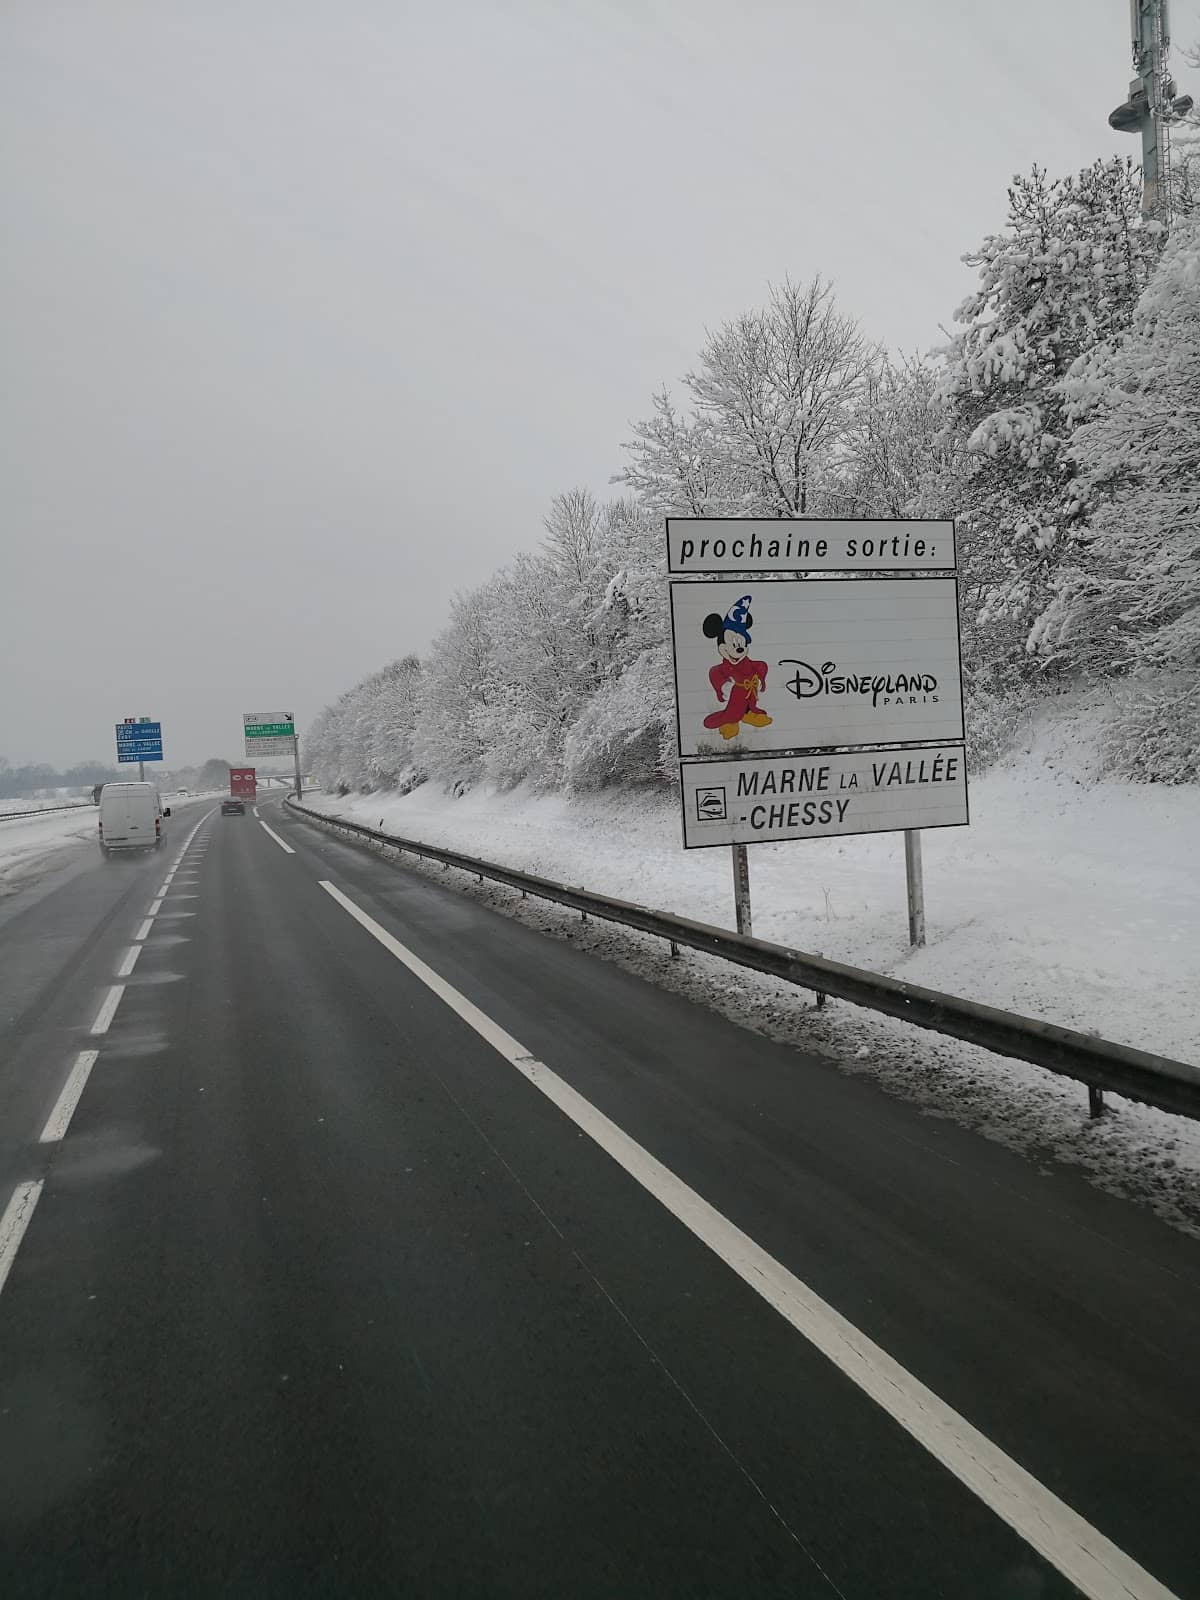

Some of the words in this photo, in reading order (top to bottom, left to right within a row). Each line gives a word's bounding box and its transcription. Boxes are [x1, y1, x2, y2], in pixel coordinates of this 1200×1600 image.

[680, 533, 828, 564] prochaine
[846, 533, 936, 558] sortie:
[883, 695, 940, 705] PARIS
[737, 766, 830, 797] MARNE
[839, 773, 858, 789] LA
[872, 753, 958, 787] VALLÉE
[740, 799, 850, 830] -CHESSY
